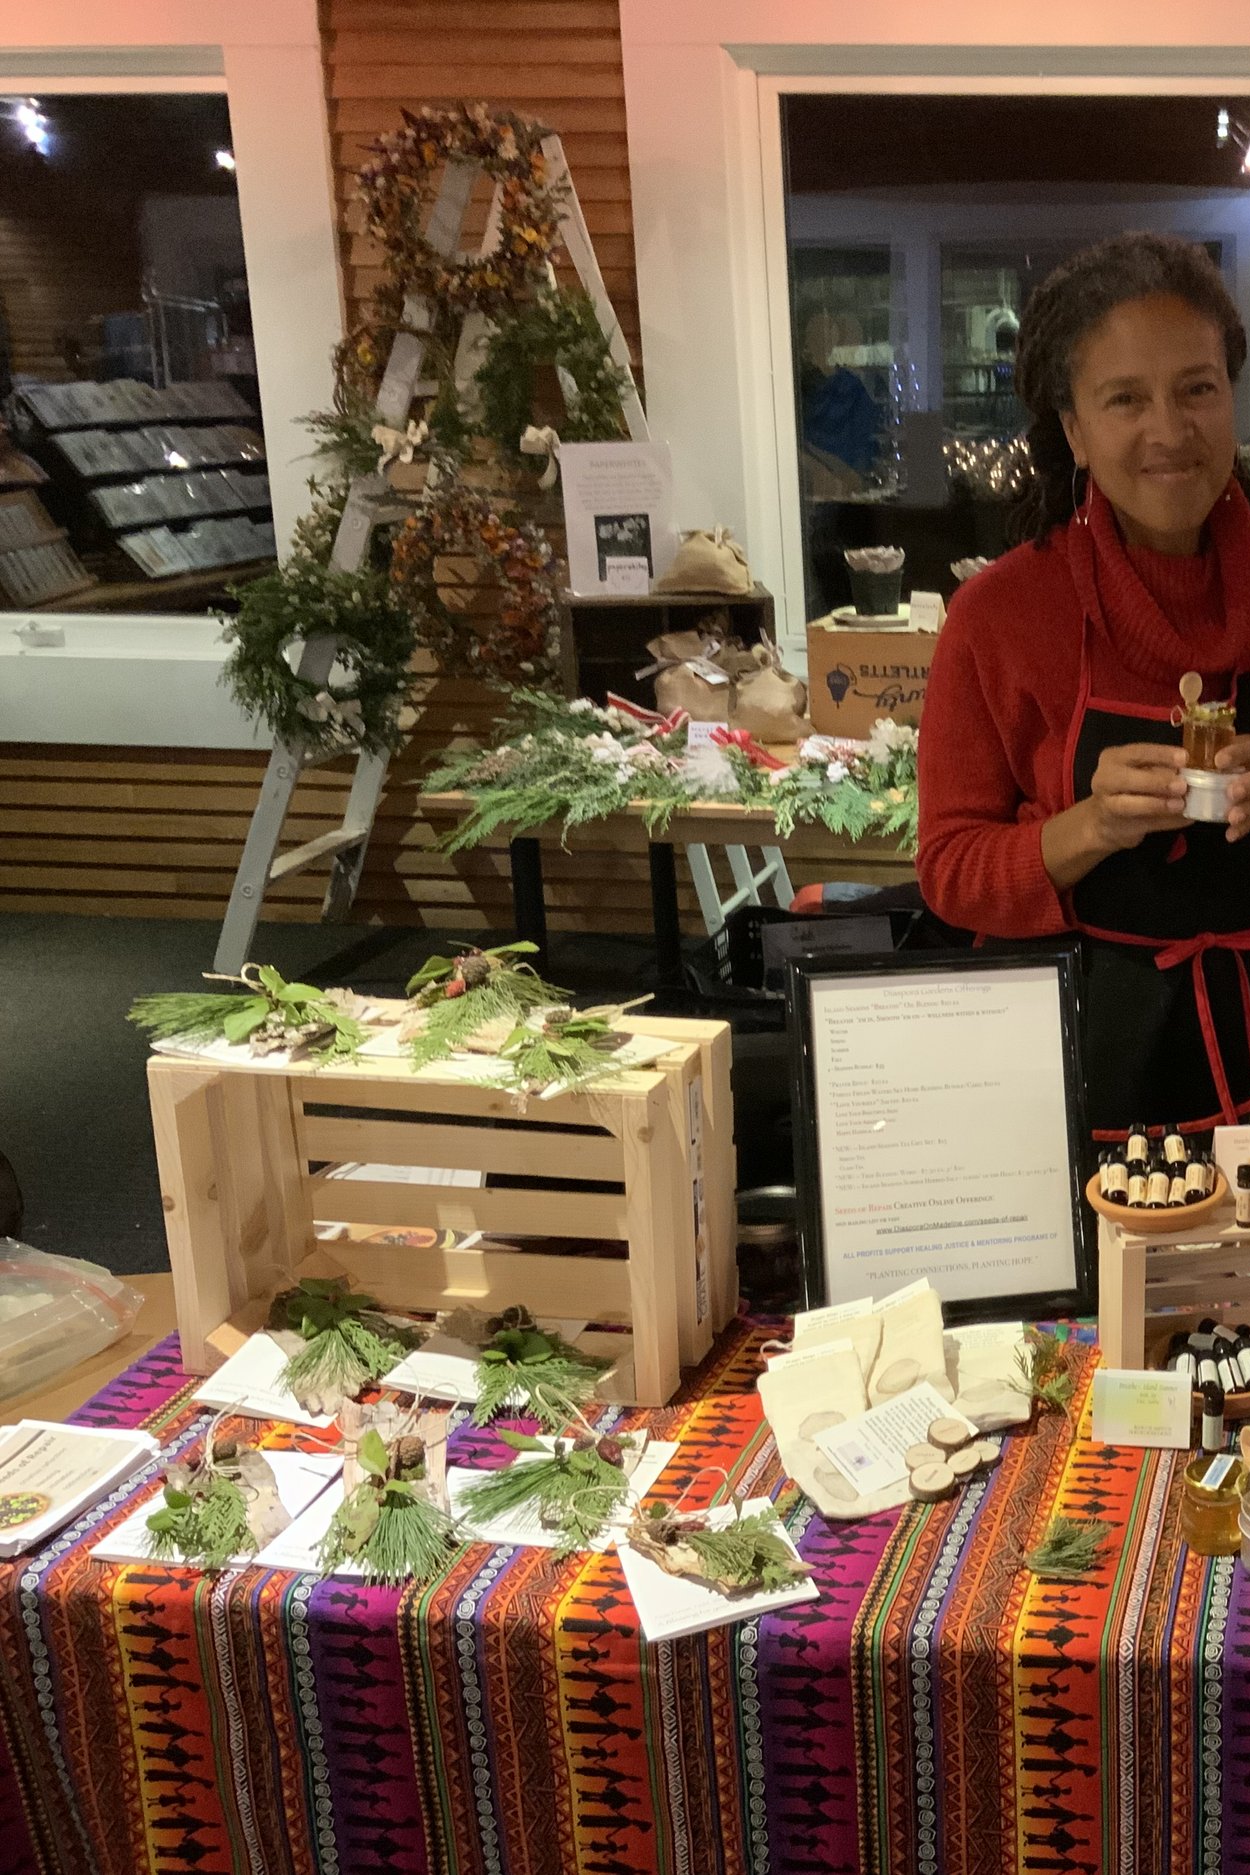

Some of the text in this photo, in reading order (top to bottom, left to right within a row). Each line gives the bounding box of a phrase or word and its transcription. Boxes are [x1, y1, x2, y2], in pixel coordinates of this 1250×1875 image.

[894, 1200, 926, 1210] CREATIVE
[928, 1198, 955, 1207] ONLINE
[843, 1252, 855, 1260] ALL
[856, 1249, 883, 1258] PROFITS
[885, 1246, 914, 1255] SUPPORT
[916, 1243, 943, 1252] HEALING
[944, 1240, 969, 1250] JUSTICE
[977, 1237, 1013, 1247] MENTORING
[1014, 1233, 1049, 1243] PROGRAMS
[972, 1259, 1011, 1270] PLANTING
[26, 1436, 57, 1460] Repair
